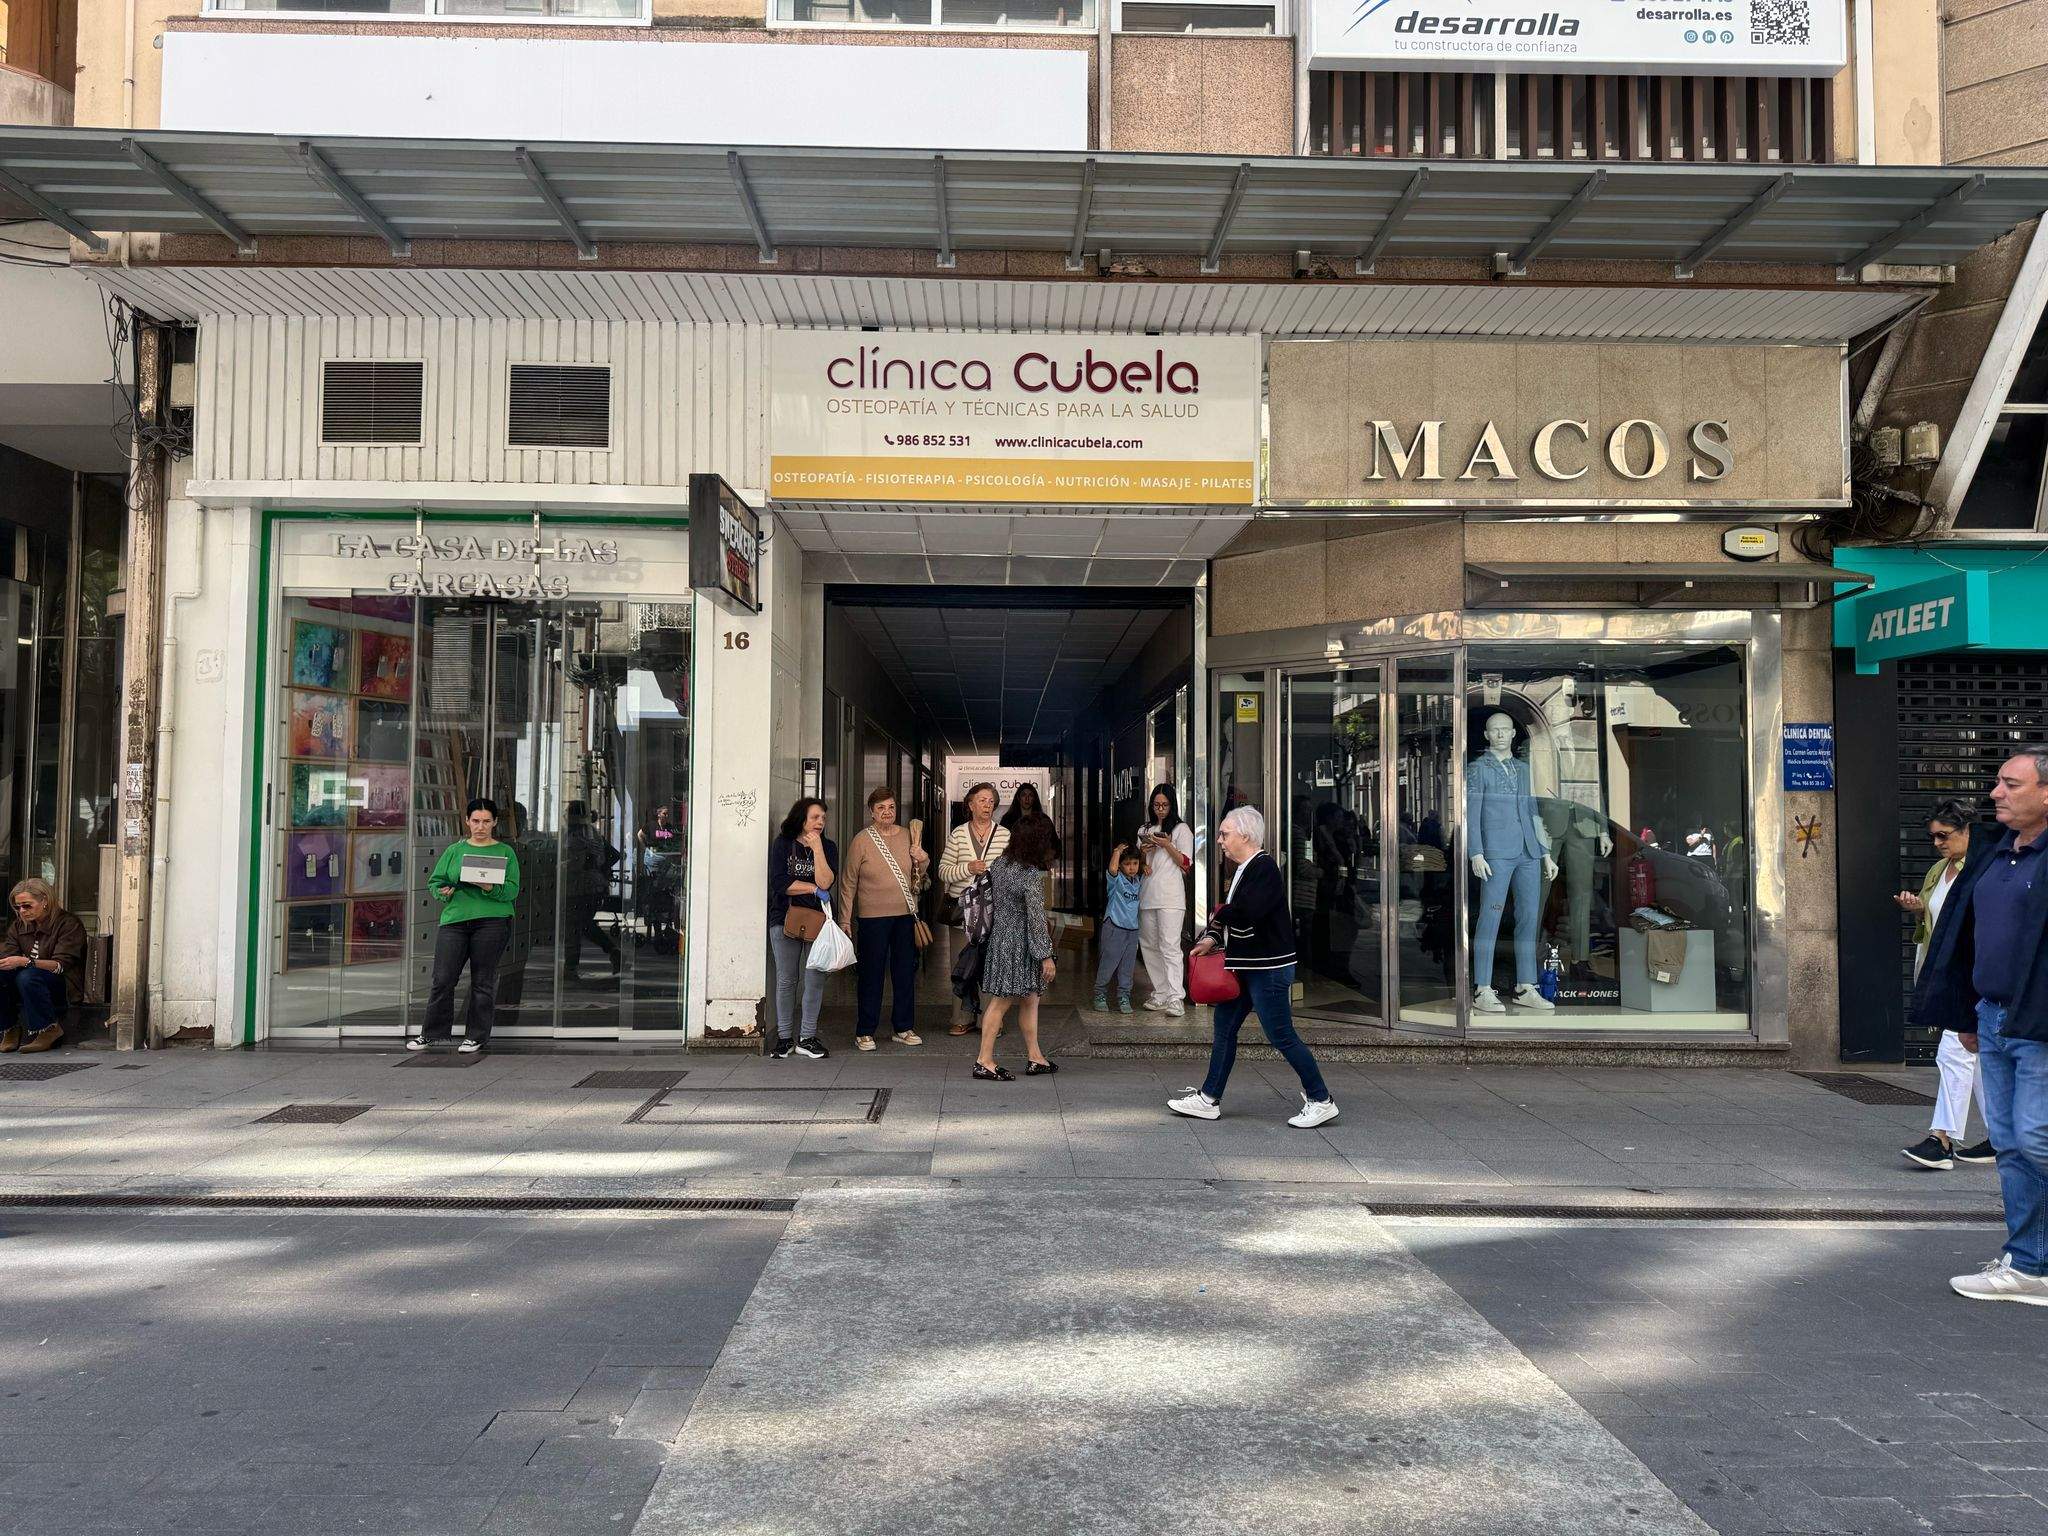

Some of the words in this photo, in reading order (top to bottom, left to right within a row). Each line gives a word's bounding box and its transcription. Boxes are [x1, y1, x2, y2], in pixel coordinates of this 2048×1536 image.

[1394, 10, 1580, 36] desarrolla
[1636, 7, 1733, 21] desarrolla.es
[1394, 40, 1407, 50] tu
[1410, 40, 1493, 52] constructora
[1496, 40, 1512, 52] de
[1515, 40, 1577, 53] confianza
[827, 346, 992, 391] clínica
[1013, 348, 1199, 394] Cubela
[826, 398, 938, 416] OSTEOPATÍA
[944, 401, 956, 416] Y
[962, 398, 1050, 417] TÉCNICAS
[1057, 402, 1104, 418] PARA
[1111, 402, 1134, 418] LA
[1141, 402, 1199, 418] SALUD
[896, 435, 920, 447] 986
[922, 435, 946, 447] 852
[949, 435, 971, 447] 531
[995, 436, 1143, 449] www.clinicacubela.com
[1364, 418, 1734, 482] MACOS
[774, 471, 856, 484] OSTEOPATÍA
[865, 473, 955, 486] FISIOTERAPIA
[965, 473, 1045, 487] PSICOLOGÍA
[1055, 474, 1130, 488] NUTRICIÓN
[1140, 477, 1191, 489] MASAJE
[1201, 477, 1252, 489] PILATES
[329, 533, 381, 559] LA
[391, 534, 486, 562] CASA
[491, 536, 538, 562] DE
[552, 537, 618, 564] LAS
[386, 571, 569, 600] CARCASAS
[1867, 596, 1955, 642] ATLEET
[723, 631, 750, 650] 16
[1808, 728, 1832, 739] DENTAL
[1000, 779, 1039, 789] Cuba
[1587, 990, 1619, 998] JONES
